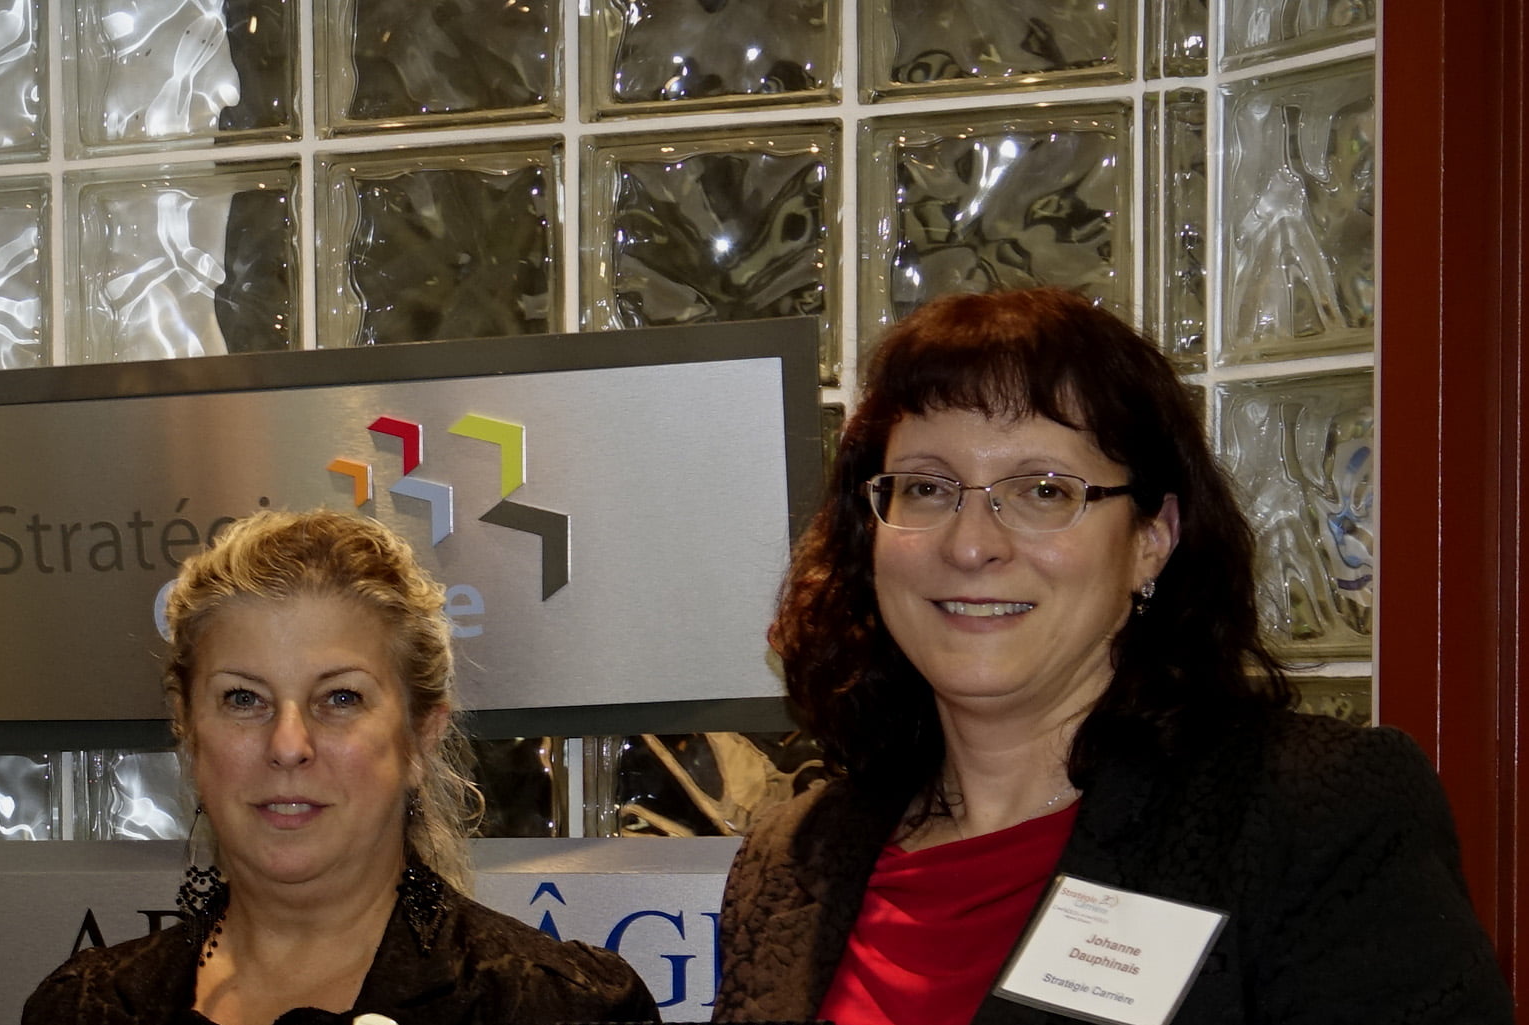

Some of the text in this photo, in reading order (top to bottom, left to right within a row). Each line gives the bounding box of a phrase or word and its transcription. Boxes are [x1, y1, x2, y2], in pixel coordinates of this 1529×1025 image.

[1086, 934, 1142, 957] Johanne
[1069, 947, 1141, 976] Dauphinais
[1042, 972, 1135, 1006] Stratégie Carrière
